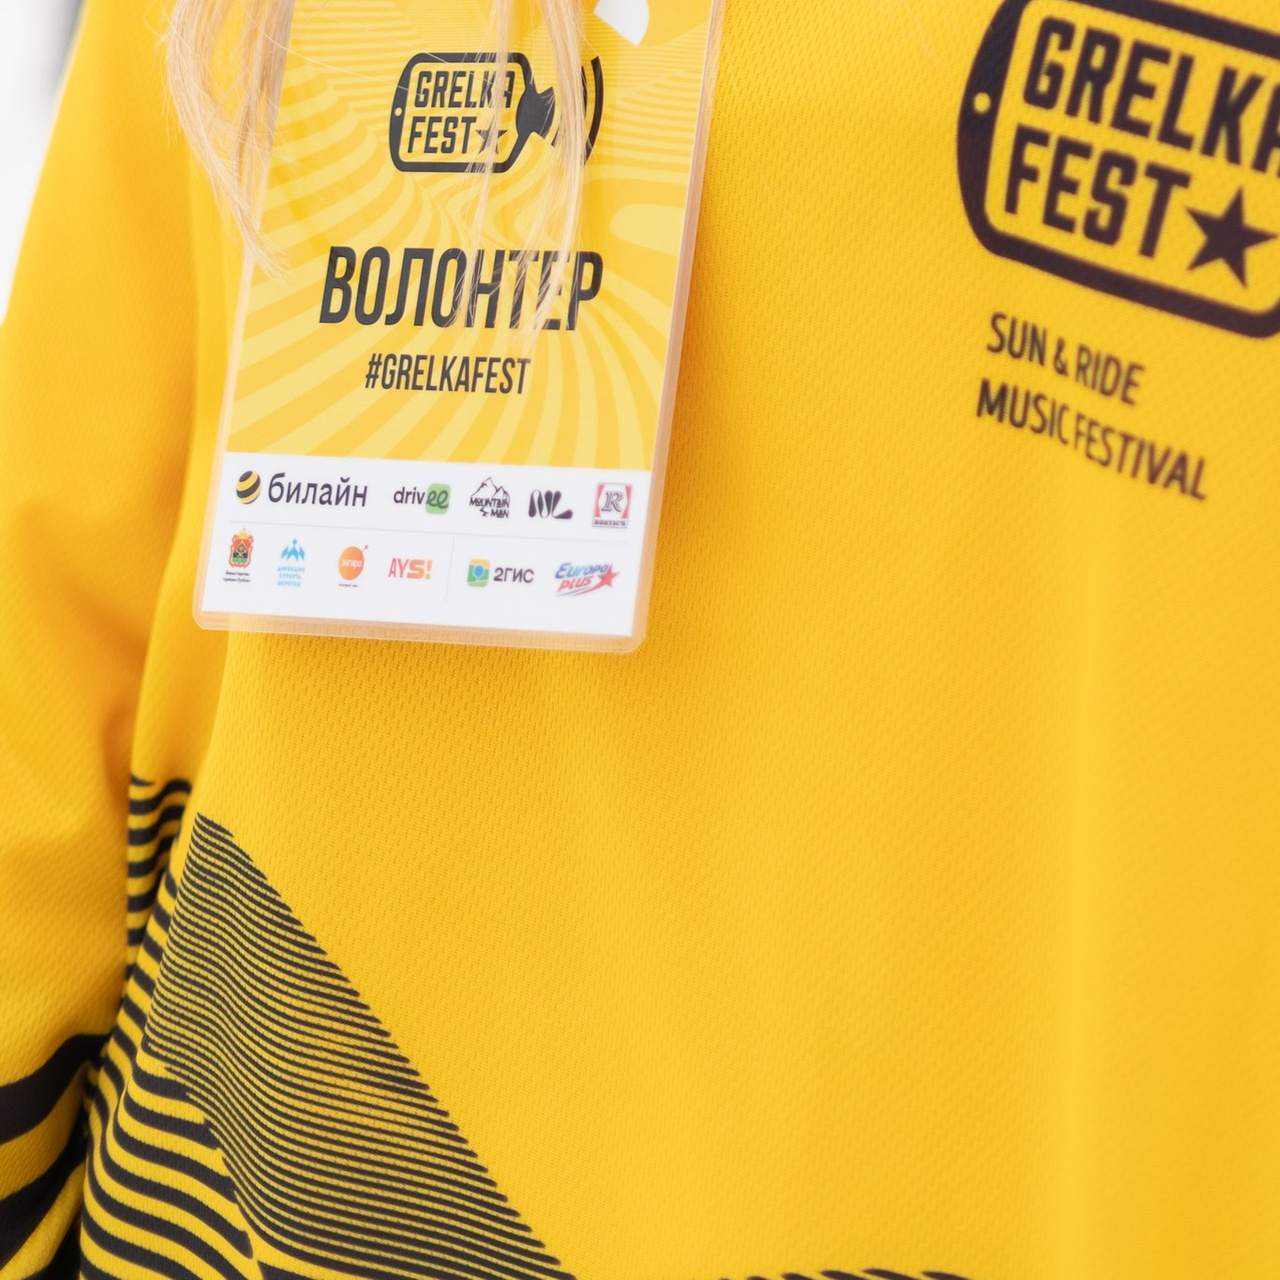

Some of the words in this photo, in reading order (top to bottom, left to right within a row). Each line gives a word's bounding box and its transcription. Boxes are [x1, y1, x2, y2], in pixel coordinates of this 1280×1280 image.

[406, 115, 478, 155] FEST
[1003, 122, 1192, 260] FEST
[318, 245, 604, 331] ВОЛОНТЕР
[364, 352, 532, 395] #GRELKAFEST
[986, 310, 1048, 368] SUN
[1053, 336, 1070, 378] &
[1075, 343, 1146, 407] RIDE
[976, 376, 1071, 446] MUSIC
[1073, 410, 1207, 502] FESTIVAL
[267, 472, 368, 507] билайн
[393, 486, 450, 510] drivee
[469, 497, 510, 508] MOUNTAIN
[490, 508, 509, 519] MAN
[388, 558, 433, 580] AYS!
[493, 566, 535, 585] 2ГИС
